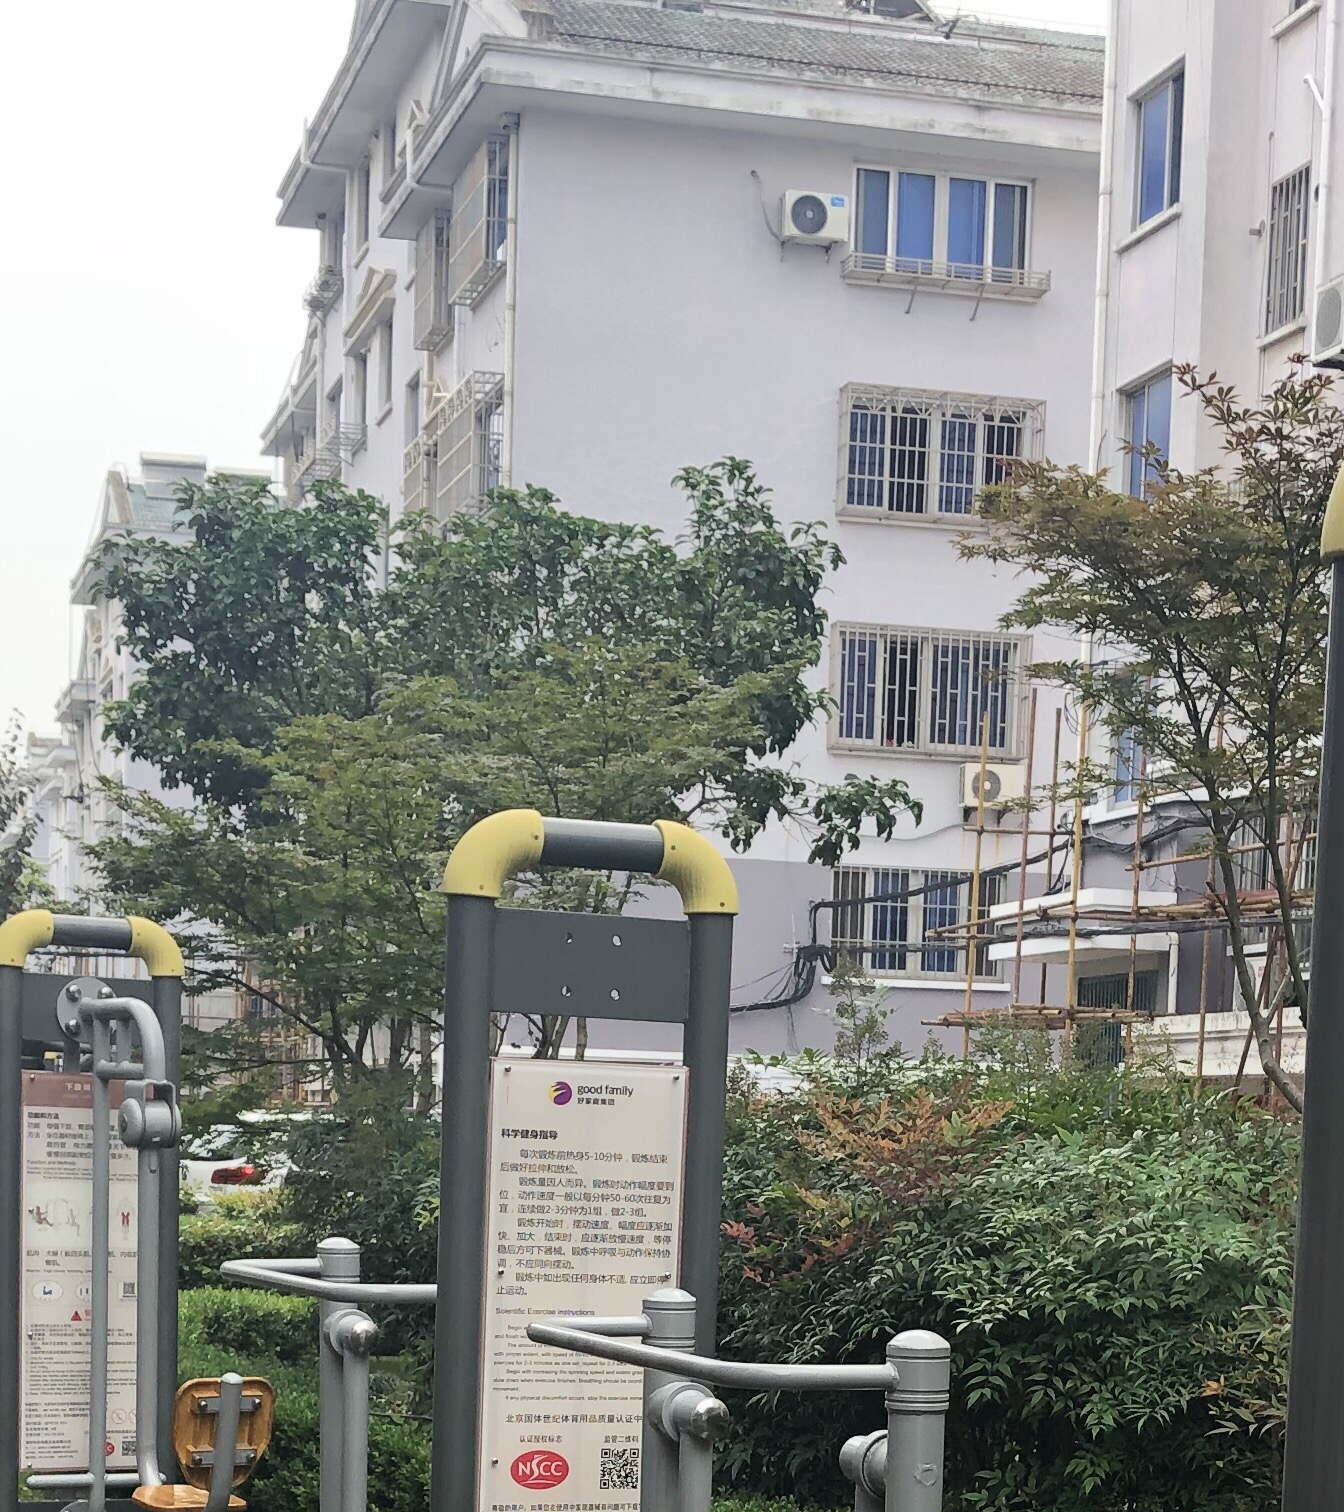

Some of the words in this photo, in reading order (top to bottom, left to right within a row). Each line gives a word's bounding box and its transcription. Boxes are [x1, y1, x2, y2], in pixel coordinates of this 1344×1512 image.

[577, 1085, 603, 1096] good
[605, 1085, 634, 1098] family
[501, 1128, 558, 1141] 科学健身指导
[496, 1285, 528, 1296] 止运动。
[505, 1414, 644, 1425] 北京国体世纪体育用品质量认证中
[603, 1435, 639, 1444] 监管二维码
[518, 1454, 564, 1481] NSCC
